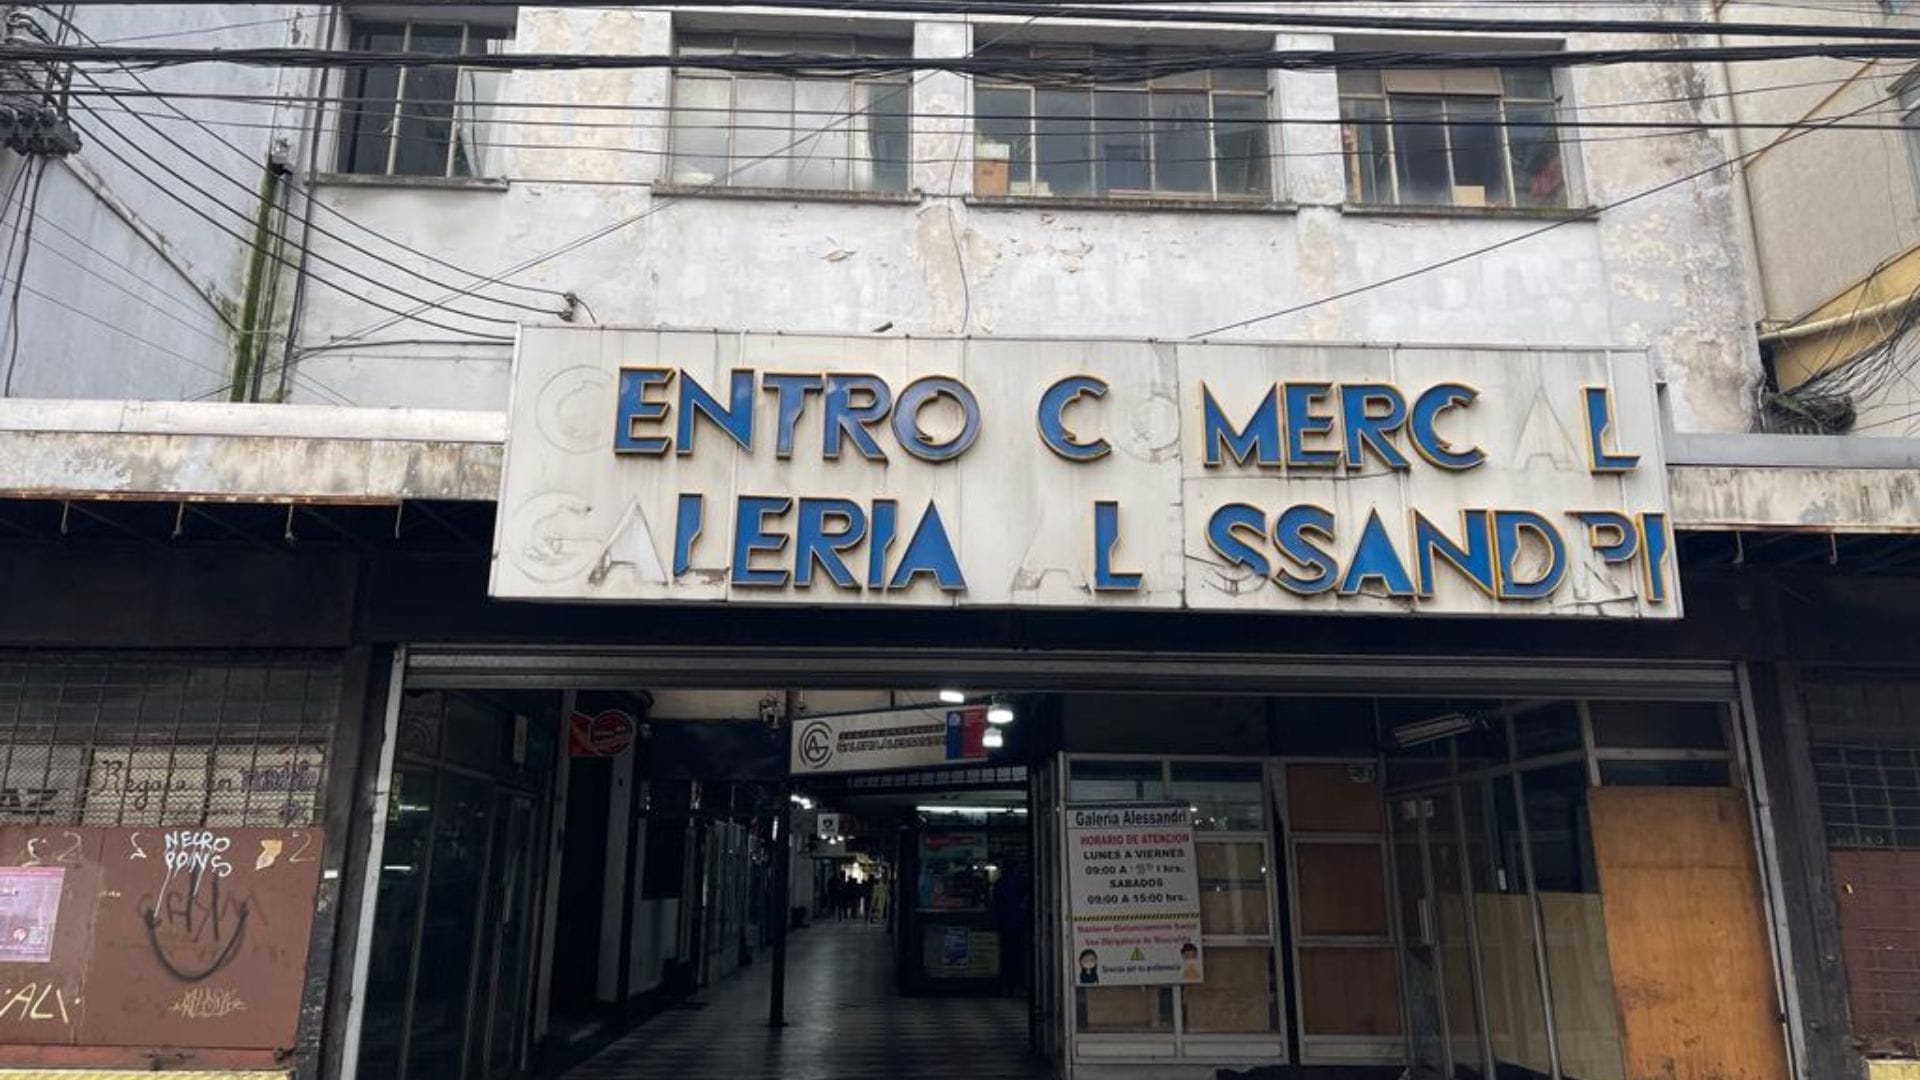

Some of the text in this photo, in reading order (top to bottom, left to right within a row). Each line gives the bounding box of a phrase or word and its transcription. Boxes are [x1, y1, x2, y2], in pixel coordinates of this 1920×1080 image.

[1080, 834, 1124, 845] HORARIO
[1126, 834, 1139, 845] DE
[1083, 848, 1185, 860] LUNES A VIERNES
[1085, 865, 1116, 875] 09:00
[1119, 865, 1128, 874] A
[1109, 878, 1164, 888] SABADOS
[1121, 894, 1130, 903] A
[1132, 893, 1163, 903] 15:00
